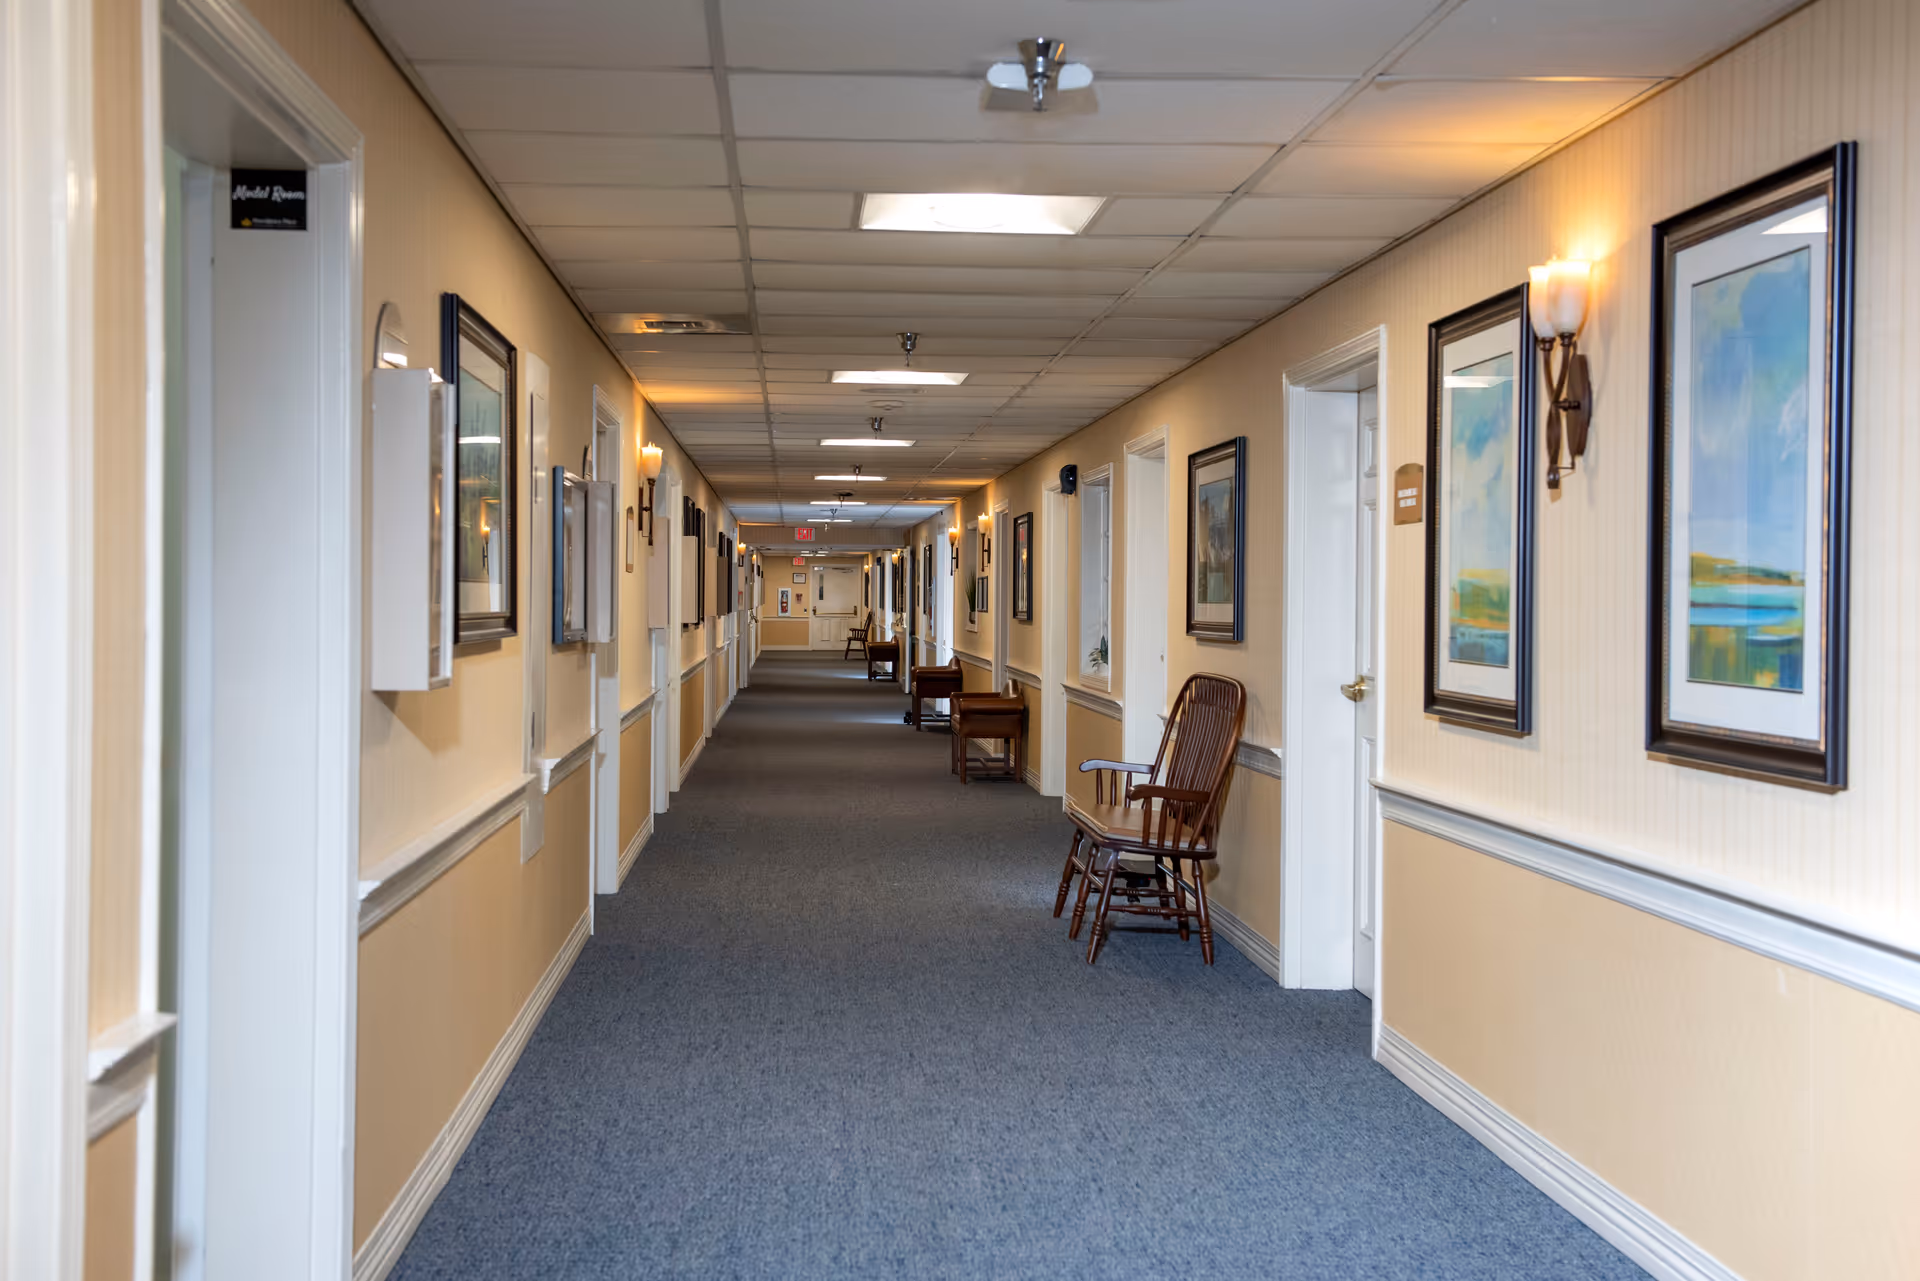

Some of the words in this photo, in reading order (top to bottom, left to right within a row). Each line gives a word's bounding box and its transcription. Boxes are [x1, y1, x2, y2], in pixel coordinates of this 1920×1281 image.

[232, 184, 270, 201] Model
[271, 185, 305, 203] Room
[797, 527, 813, 540] EXIT
[794, 557, 804, 565] EXIT
